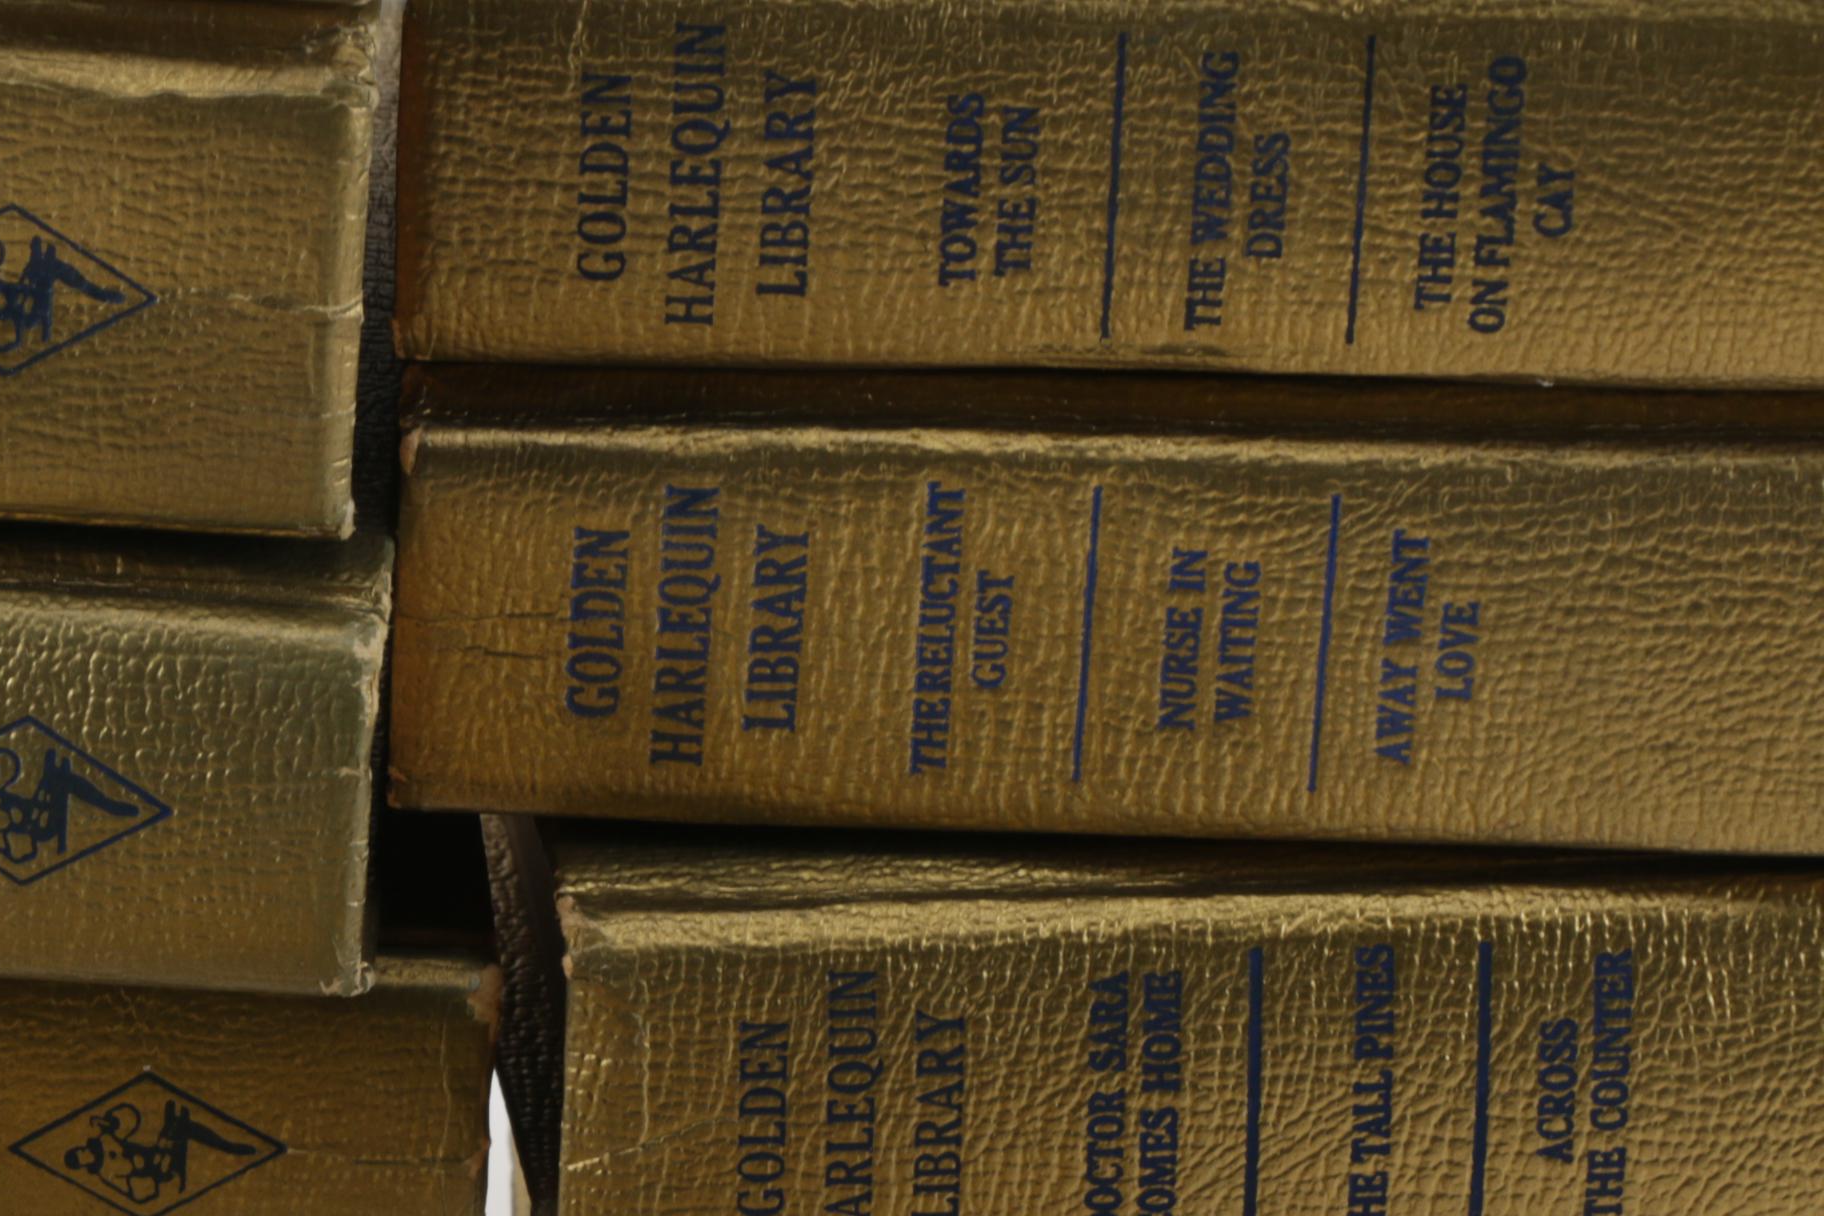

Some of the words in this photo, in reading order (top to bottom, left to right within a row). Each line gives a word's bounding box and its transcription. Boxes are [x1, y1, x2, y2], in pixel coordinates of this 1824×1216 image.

[578, 72, 635, 279] GOLDEN
[667, 22, 732, 323] HARLEQUIN
[758, 70, 818, 294] LIBRARY
[940, 93, 985, 285] TOWARDS
[999, 107, 1040, 185] SUN
[1191, 51, 1241, 244] WEDDING
[1245, 131, 1291, 257] DRESS
[1423, 83, 1469, 218] HOUSE
[1475, 54, 1527, 265] FLAMINGO
[1535, 164, 1576, 237] CAY
[995, 197, 1037, 276] THE
[1187, 258, 1226, 328] THE
[1415, 232, 1456, 309] THE
[1469, 281, 1507, 331] ON
[565, 527, 630, 717] GOLDEN
[651, 484, 721, 764] HARLEQUIN
[742, 525, 809, 731] LIBRARY
[914, 482, 966, 692] RELUCTANT
[970, 570, 1014, 690] GUEST
[1168, 549, 1208, 592] IN
[1383, 529, 1430, 645] WENT
[1158, 608, 1203, 730] NURSE
[1215, 562, 1262, 721] WAITING
[1435, 602, 1480, 700] LOVE
[910, 700, 951, 773] THE
[1376, 660, 1418, 763] AWAY
[1089, 972, 1129, 1072] SARA
[1142, 972, 1182, 1091] HOME
[1354, 944, 1396, 1059] PINES
[1591, 949, 1633, 1130] COUNTER
[737, 1021, 789, 1216] GOLDEN
[1353, 1070, 1393, 1162] TALL
[1537, 1019, 1578, 1161] ACROSS
